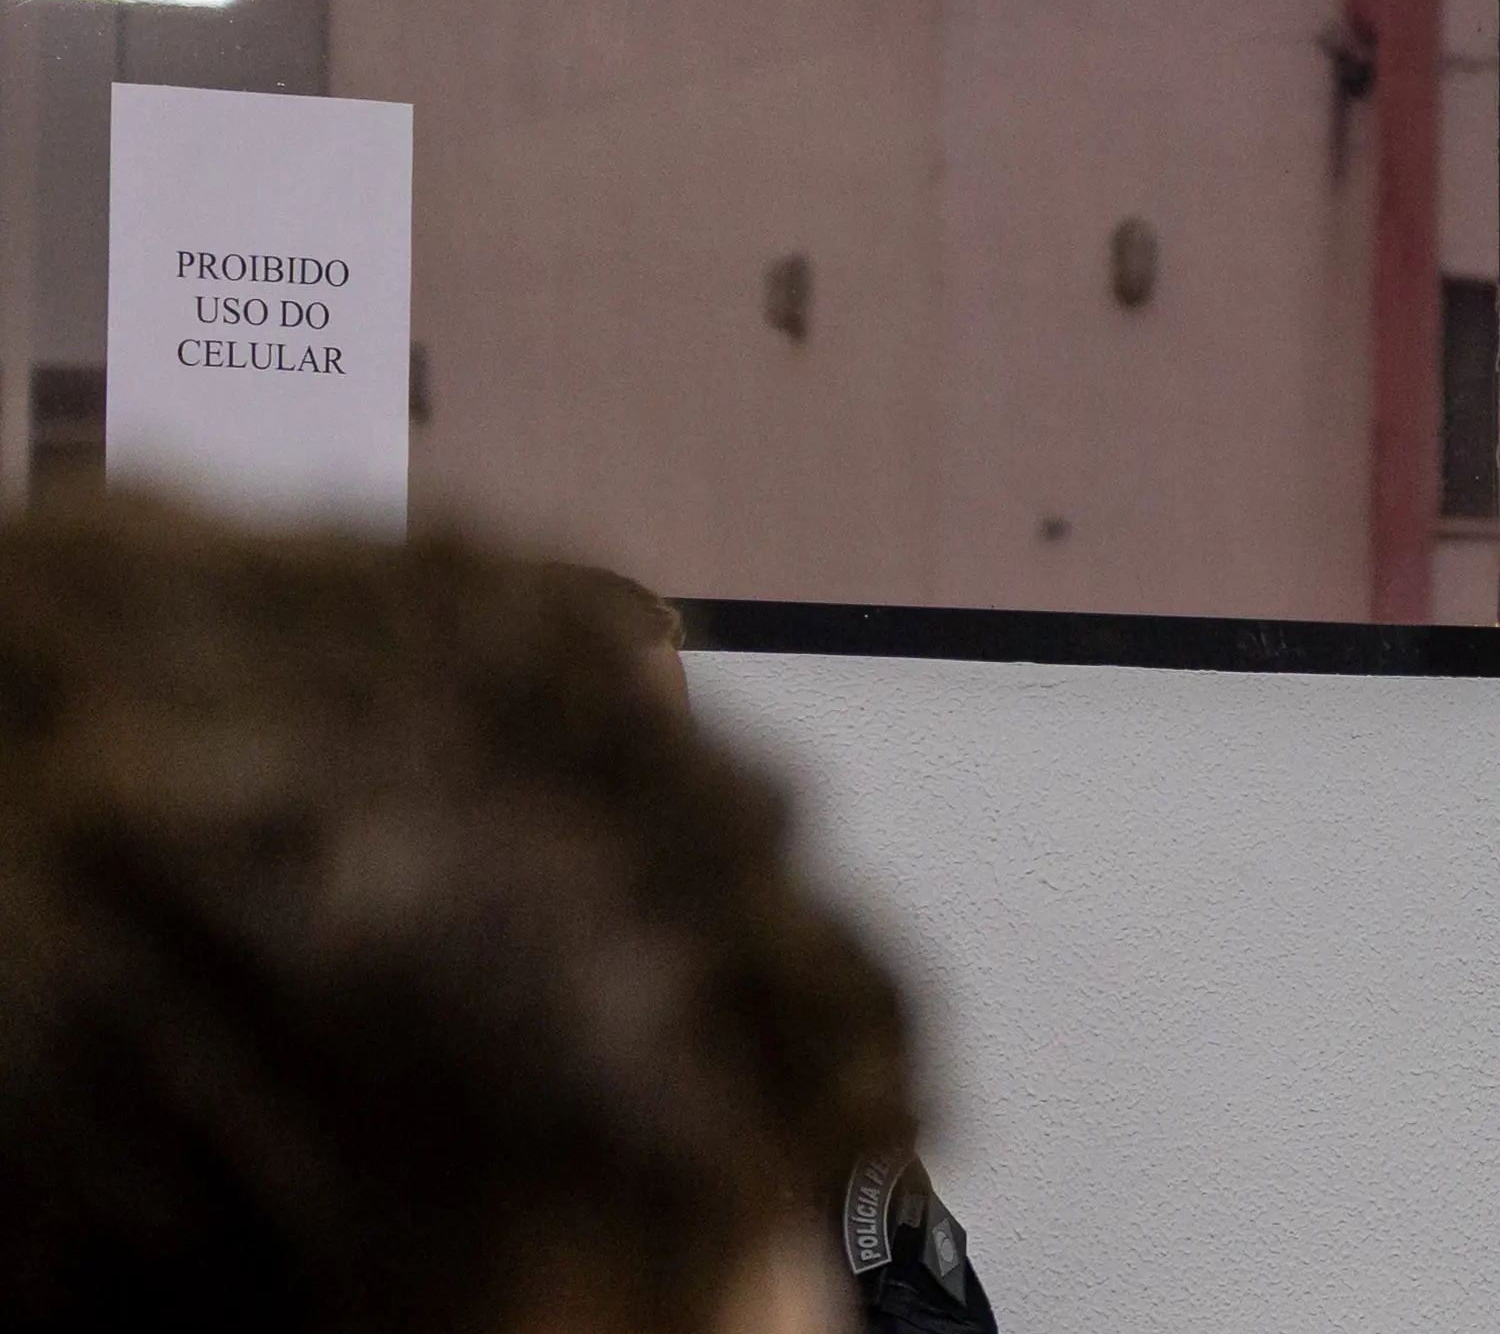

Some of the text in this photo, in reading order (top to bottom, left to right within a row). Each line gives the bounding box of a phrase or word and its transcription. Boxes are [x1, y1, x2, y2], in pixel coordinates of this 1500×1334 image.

[175, 250, 351, 288] PROIBIDO
[194, 296, 331, 330] USO DO
[177, 338, 348, 376] CELULAR
[851, 1186, 882, 1262] POLÍCIA
